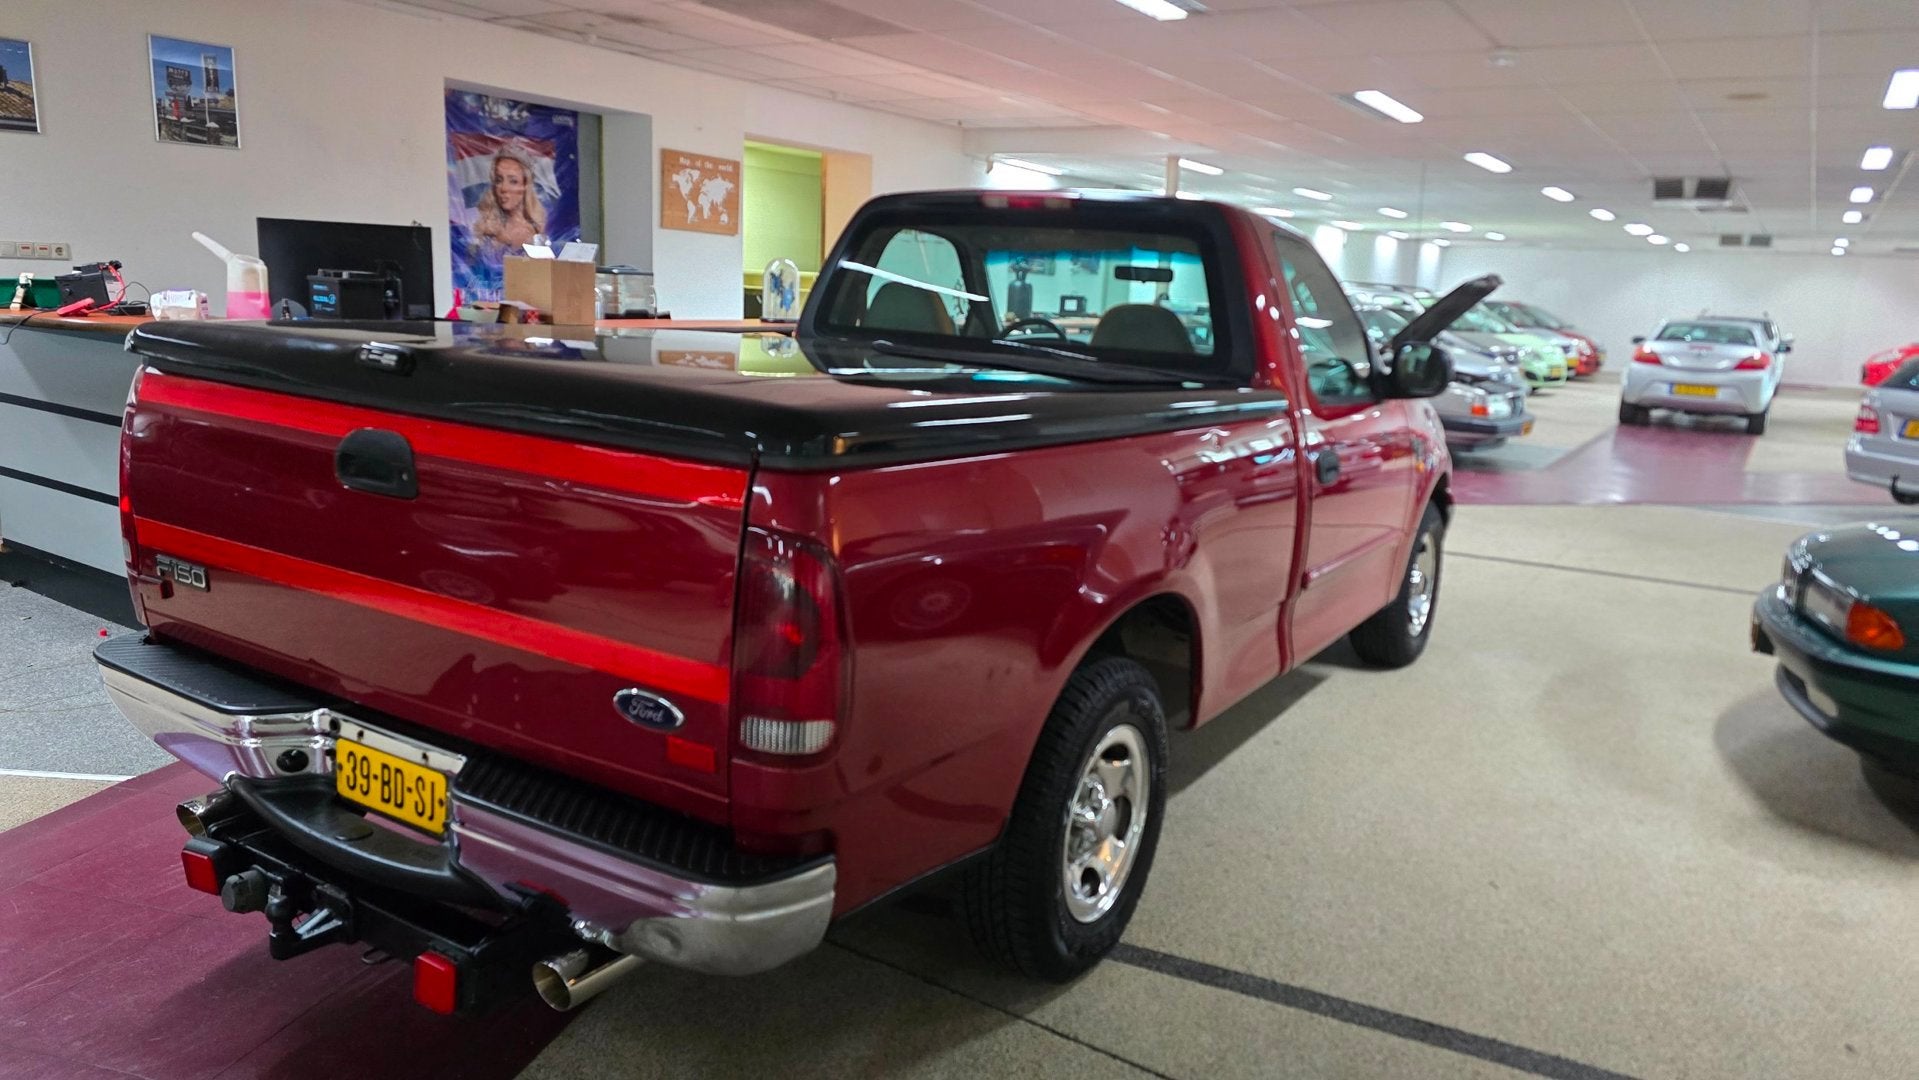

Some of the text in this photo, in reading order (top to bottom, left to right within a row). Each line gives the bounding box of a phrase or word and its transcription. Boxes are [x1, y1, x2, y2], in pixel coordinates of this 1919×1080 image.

[679, 156, 690, 166] Map
[704, 161, 713, 170] the
[718, 163, 734, 172] world
[628, 697, 664, 723] Ford
[346, 750, 435, 822] 39-BD-SJ
